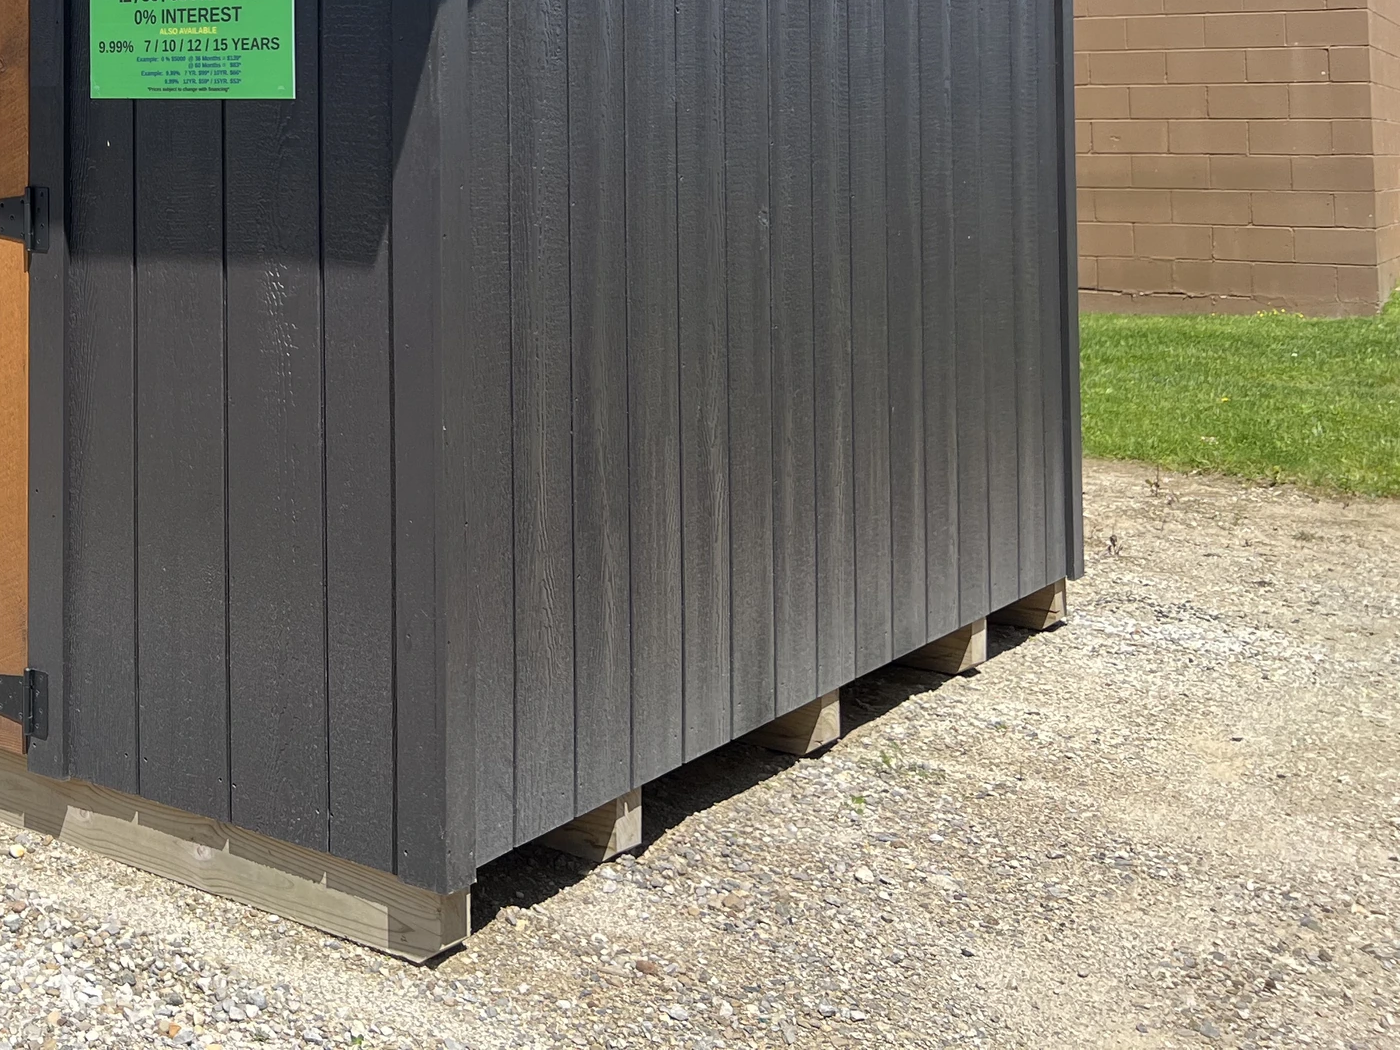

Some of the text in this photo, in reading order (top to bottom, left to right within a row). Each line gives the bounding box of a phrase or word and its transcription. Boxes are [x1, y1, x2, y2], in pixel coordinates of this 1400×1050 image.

[134, 6, 242, 25] 0% INTEREST
[159, 26, 217, 35] ALSO AVAILABLE
[98, 36, 280, 54] 9.99% 7 / 10 / 12 / 15 YEARS
